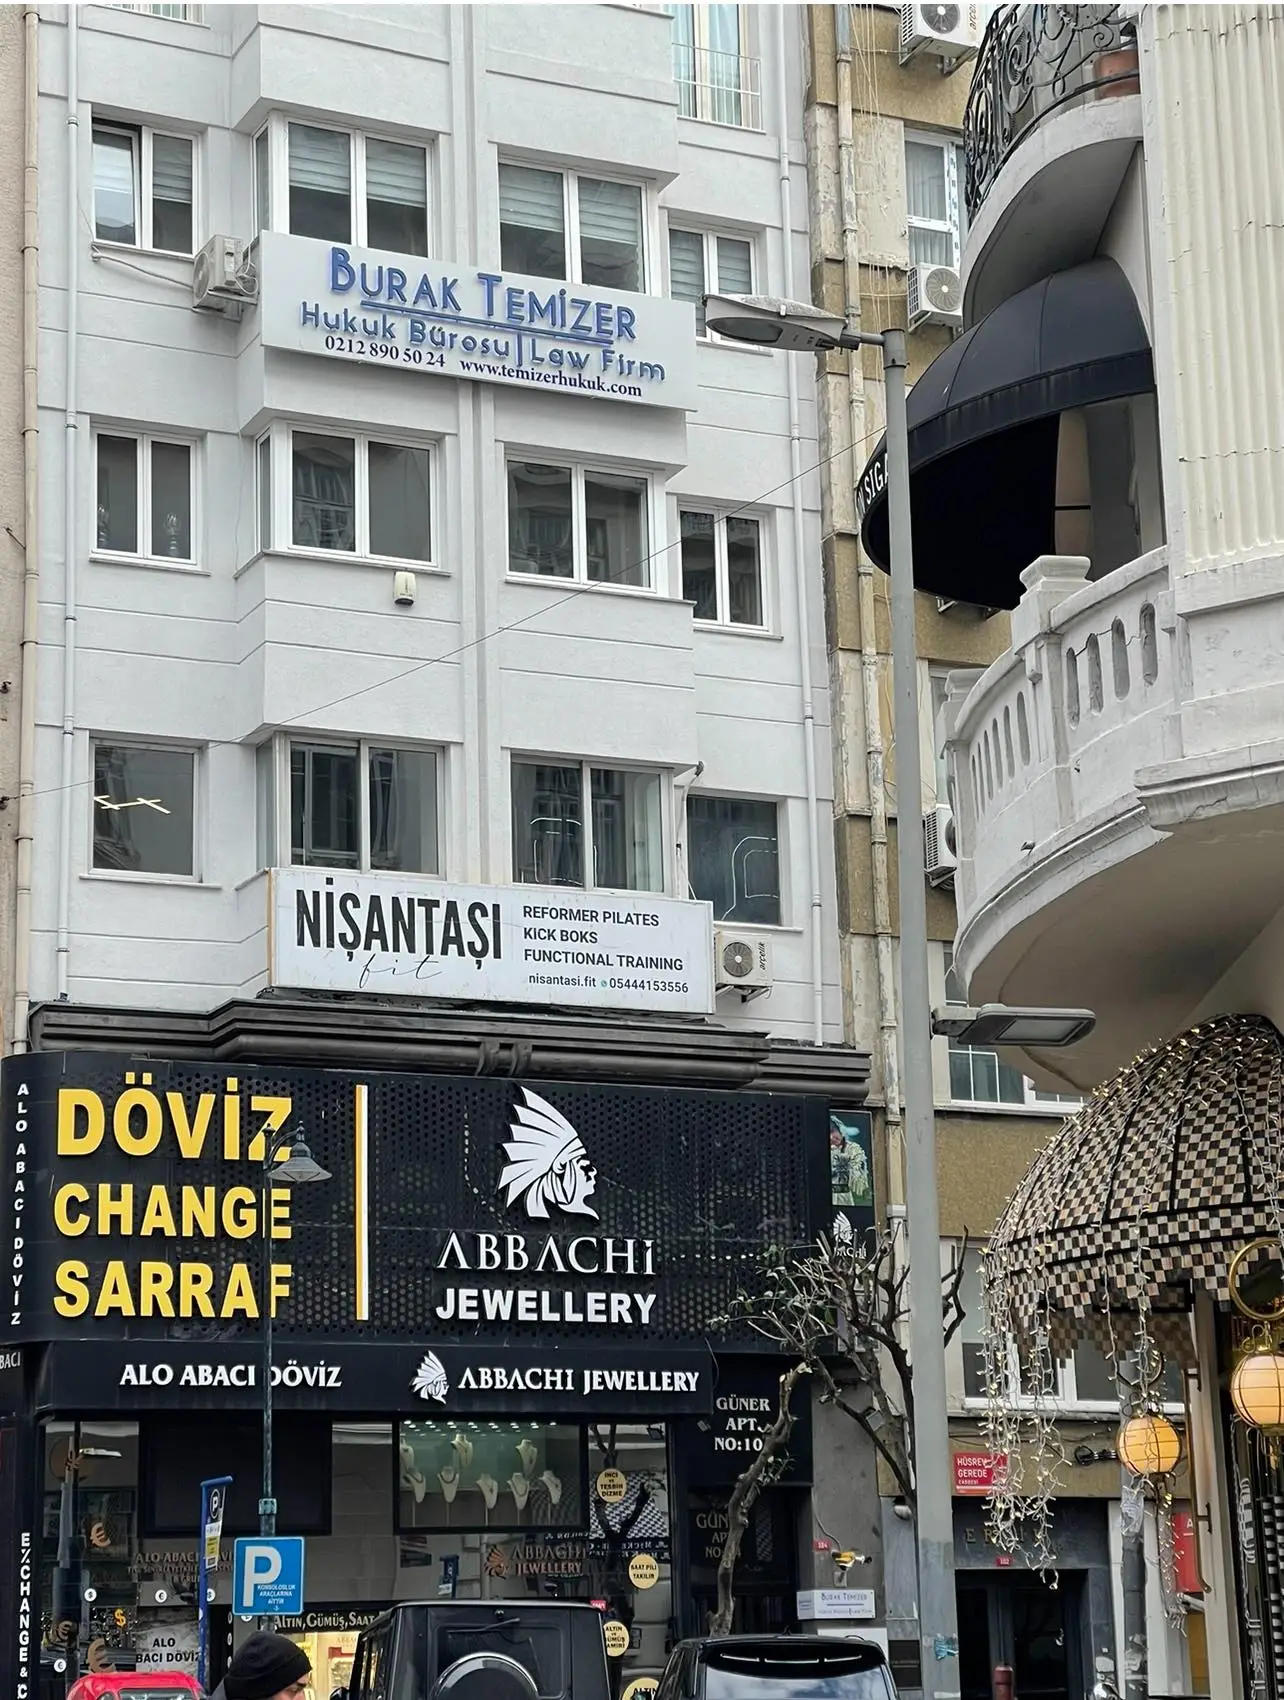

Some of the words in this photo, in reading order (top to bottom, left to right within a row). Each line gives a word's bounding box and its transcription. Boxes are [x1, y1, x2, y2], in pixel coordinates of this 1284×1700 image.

[331, 246, 462, 312] BURAK
[301, 300, 397, 340] Hukuk
[409, 317, 510, 358] Bürosu
[531, 338, 590, 371] Law
[601, 350, 667, 382] Firm
[324, 334, 366, 356] 0212
[369, 343, 400, 361] 890
[403, 347, 423, 365] 50
[425, 352, 446, 369] 24
[460, 358, 643, 398] www.temizerhukuk.com
[296, 877, 502, 971] NİŞANTAŞI
[523, 905, 599, 923] REFORMER
[602, 911, 660, 927] PILATES
[523, 927, 557, 942] KICK
[560, 930, 598, 944] BOKS
[524, 949, 614, 967] FUNCTIONAL
[616, 954, 684, 971] TRAINING
[358, 954, 443, 990] fit
[528, 973, 597, 988] nisantasi.fit
[609, 978, 689, 994] 05444153556
[57, 1071, 293, 1161] DÖVİZ
[54, 1182, 292, 1239] CHANGE
[53, 1259, 293, 1318] SARRAF
[435, 1287, 657, 1324] JEWELLERY
[0, 1351, 21, 1370] BACI
[119, 1363, 174, 1386] ALO
[179, 1365, 256, 1387] ABACI
[458, 1366, 575, 1391] ABBACHI
[583, 1369, 700, 1395] JEWELLERY
[715, 1393, 771, 1412] GÜNER
[714, 1436, 764, 1452] NO:10
[957, 1469, 988, 1479] GEREDE
[695, 1510, 729, 1529] GÜN
[712, 1531, 729, 1544] AP
[242, 1545, 283, 1607] P
[152, 1637, 176, 1648] ALO
[136, 1652, 163, 1664] BACI
